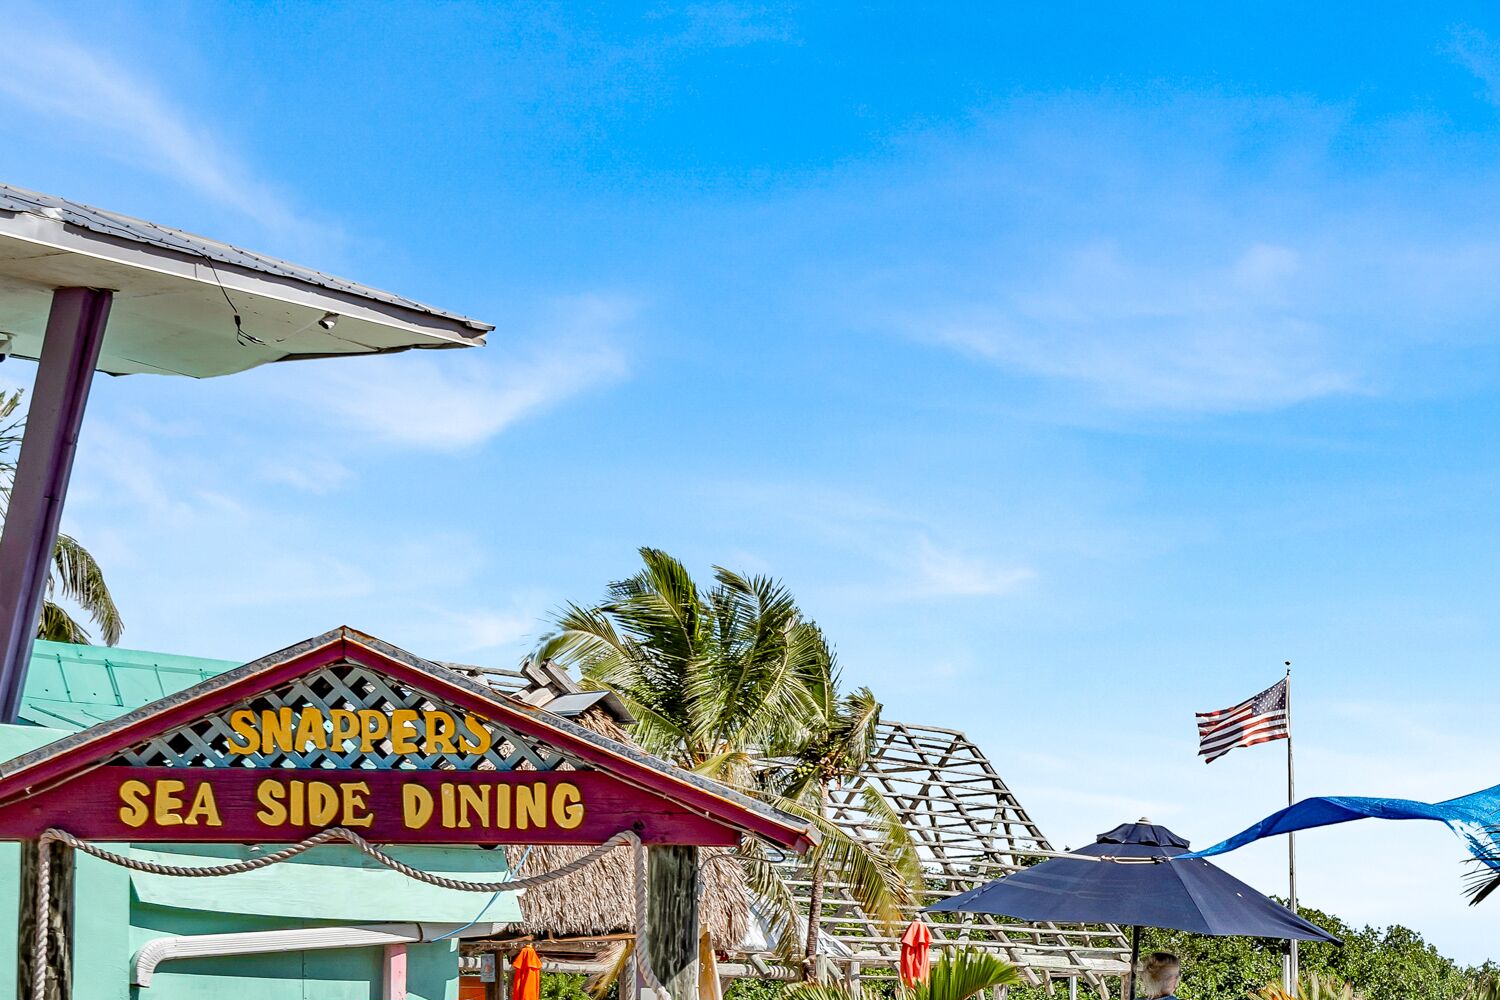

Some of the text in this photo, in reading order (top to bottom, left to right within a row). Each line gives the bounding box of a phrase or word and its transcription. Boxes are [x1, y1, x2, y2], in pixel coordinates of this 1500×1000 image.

[228, 707, 491, 755] SNAPPERS
[119, 779, 585, 829] SEA SIDE DINING
